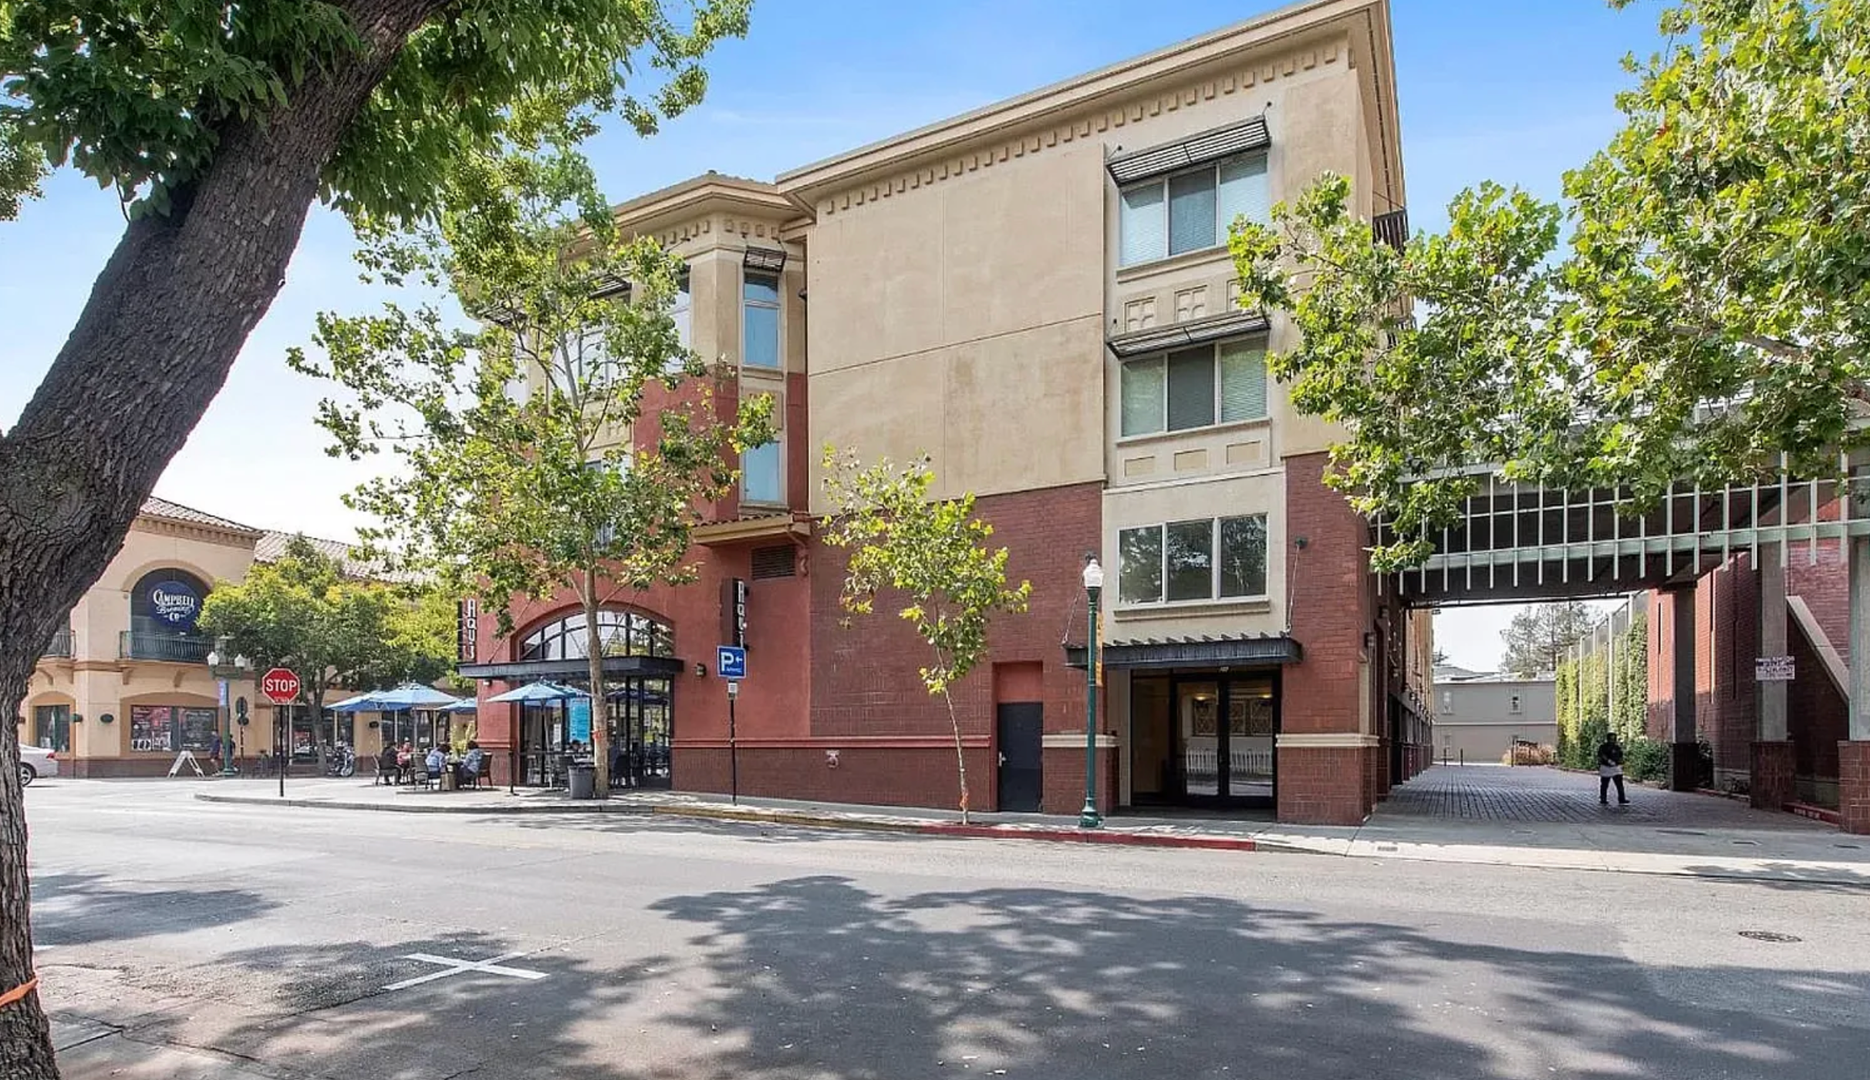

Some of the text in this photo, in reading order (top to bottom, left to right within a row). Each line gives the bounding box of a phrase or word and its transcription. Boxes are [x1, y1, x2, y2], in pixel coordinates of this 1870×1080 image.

[153, 588, 194, 607] CAMPBELL
[721, 652, 734, 672] P
[265, 679, 297, 692] STOP
